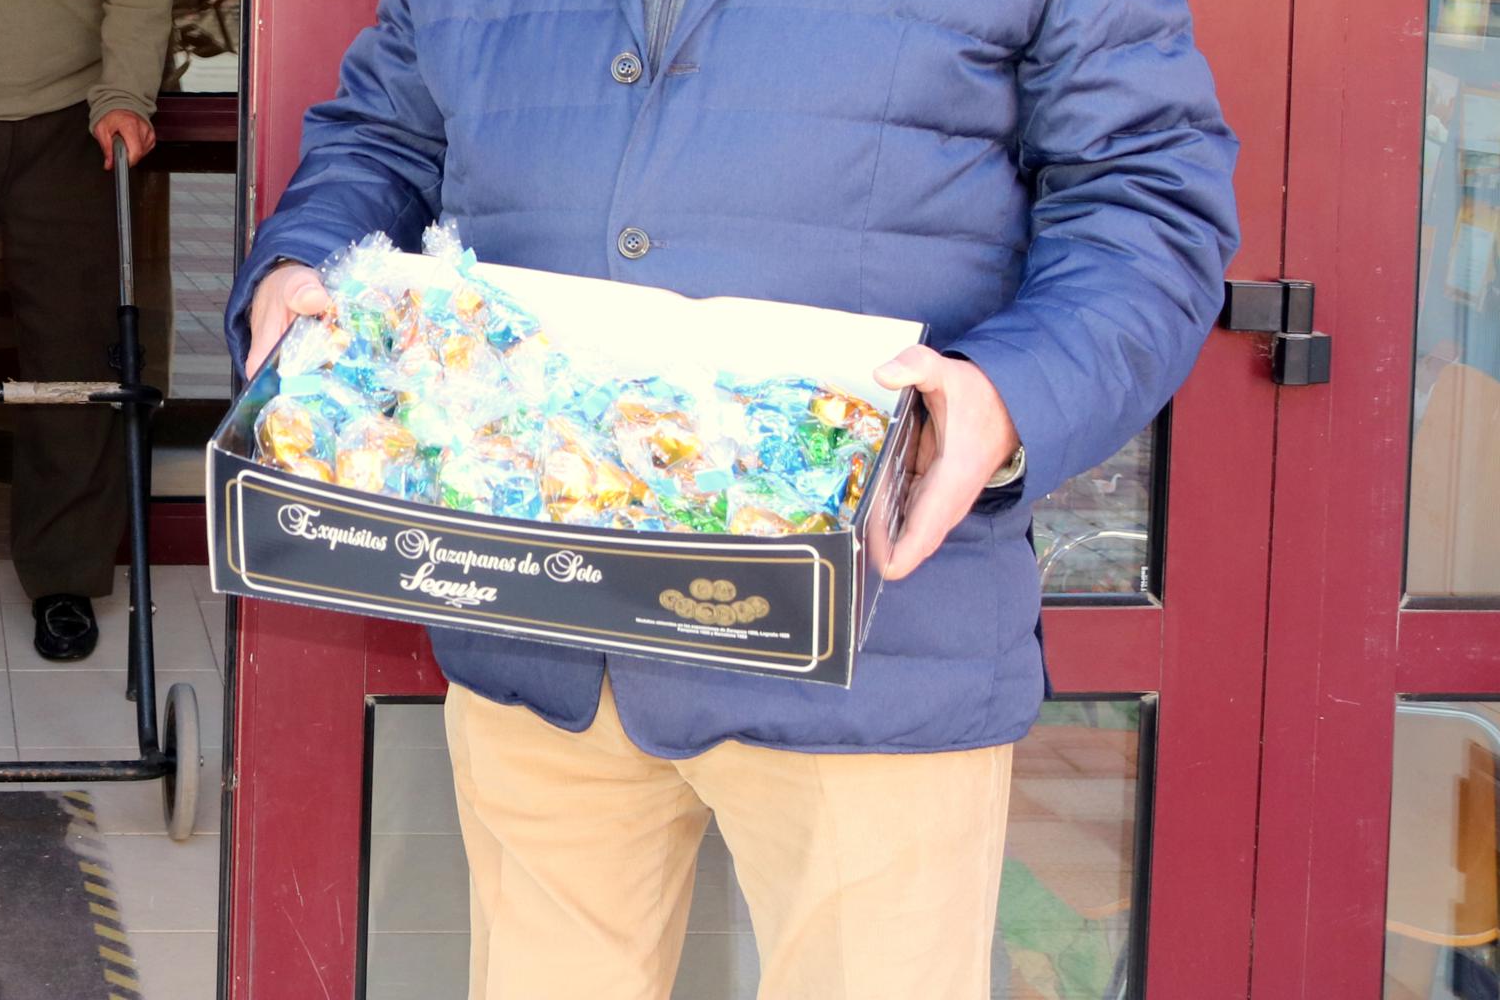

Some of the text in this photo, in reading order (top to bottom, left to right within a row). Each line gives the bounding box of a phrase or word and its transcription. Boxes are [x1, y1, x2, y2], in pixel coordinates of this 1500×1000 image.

[278, 504, 602, 583] Exquisitos Mazapanes de Soto
[400, 563, 498, 608] Segura
